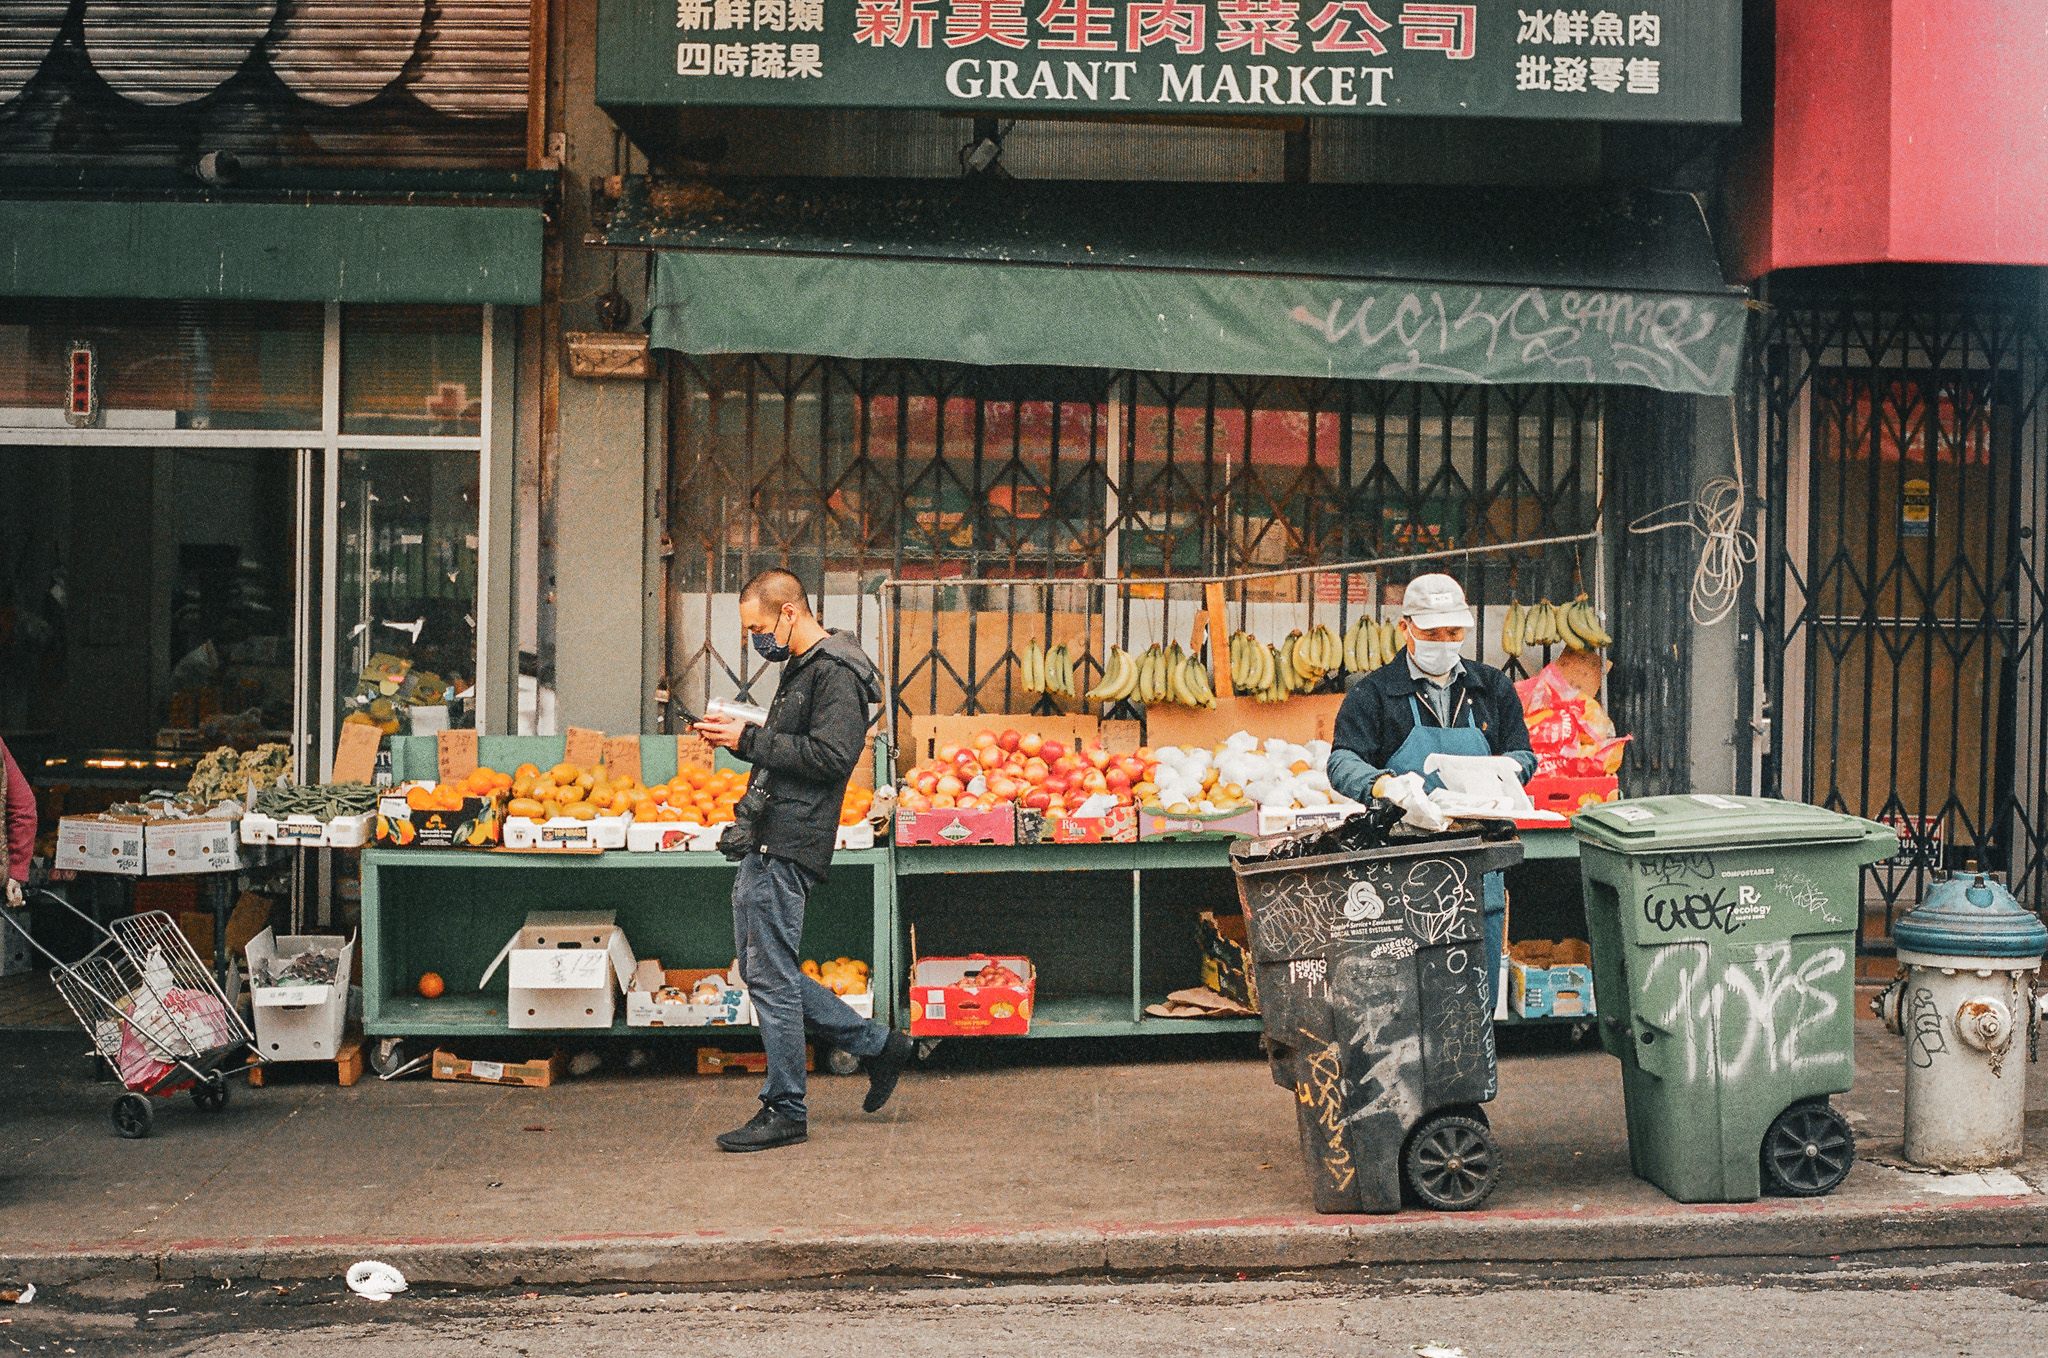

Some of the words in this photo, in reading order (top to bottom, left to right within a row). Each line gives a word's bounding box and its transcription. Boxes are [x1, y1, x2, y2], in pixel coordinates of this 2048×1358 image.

[676, 0, 825, 32] 新鮮肉類
[1516, 9, 1661, 47] 冰鮮魚肉
[677, 42, 824, 79] 四時蔬果
[1515, 54, 1660, 94] 批發零售
[945, 58, 1137, 101] GRANT
[1157, 63, 1394, 106] MARKET
[1721, 868, 1775, 878] COMPOSTABLES
[1372, 918, 1404, 926] Environment
